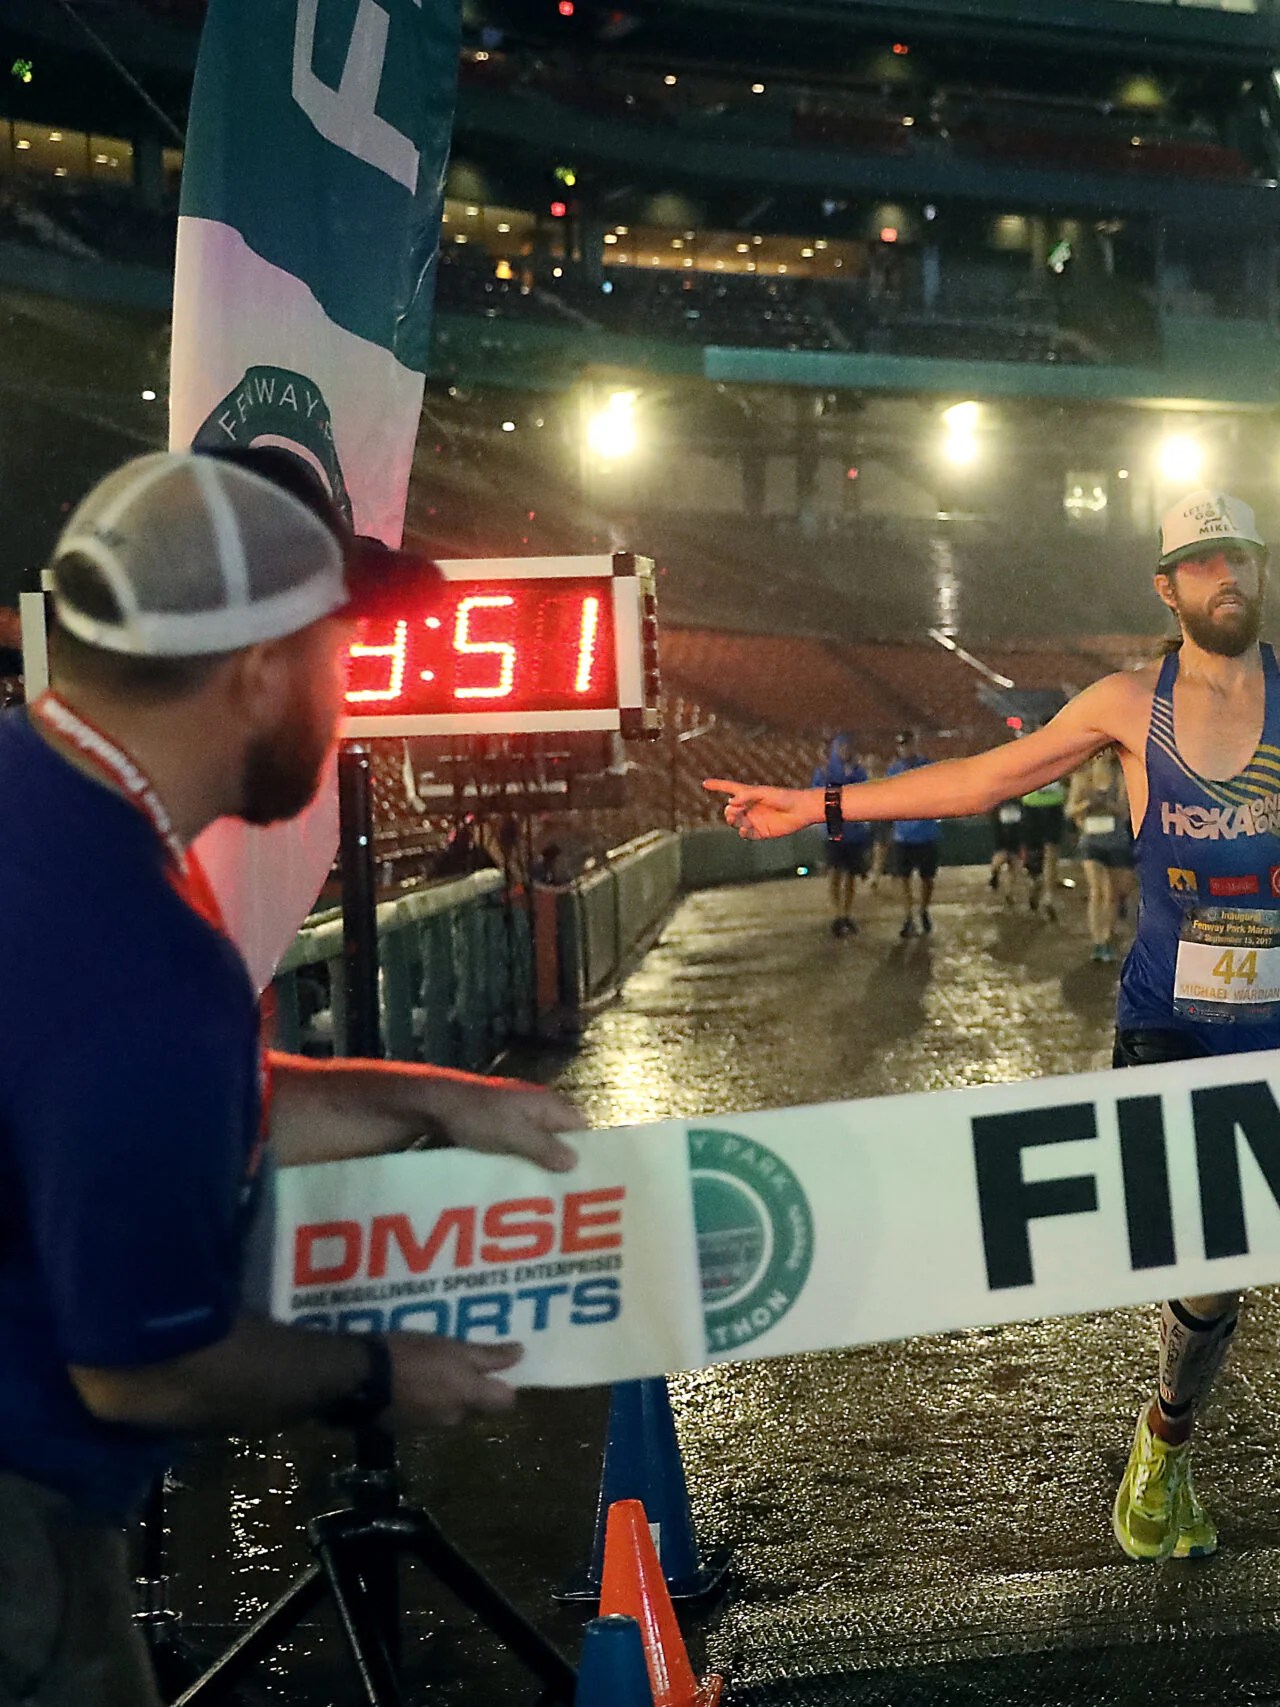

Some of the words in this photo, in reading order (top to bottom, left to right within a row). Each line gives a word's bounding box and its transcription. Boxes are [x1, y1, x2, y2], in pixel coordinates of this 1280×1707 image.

[1161, 801, 1256, 840] HOKA
[1193, 920, 1225, 934] Fenway
[1226, 923, 1246, 934] Park
[1256, 937, 1273, 946] 2017
[1212, 949, 1258, 985] 44
[1182, 983, 1228, 999] MICHAEL
[293, 1186, 627, 1288] DMSE
[442, 1268, 508, 1293] SPORTS
[514, 1253, 623, 1283] ENTERPRISES
